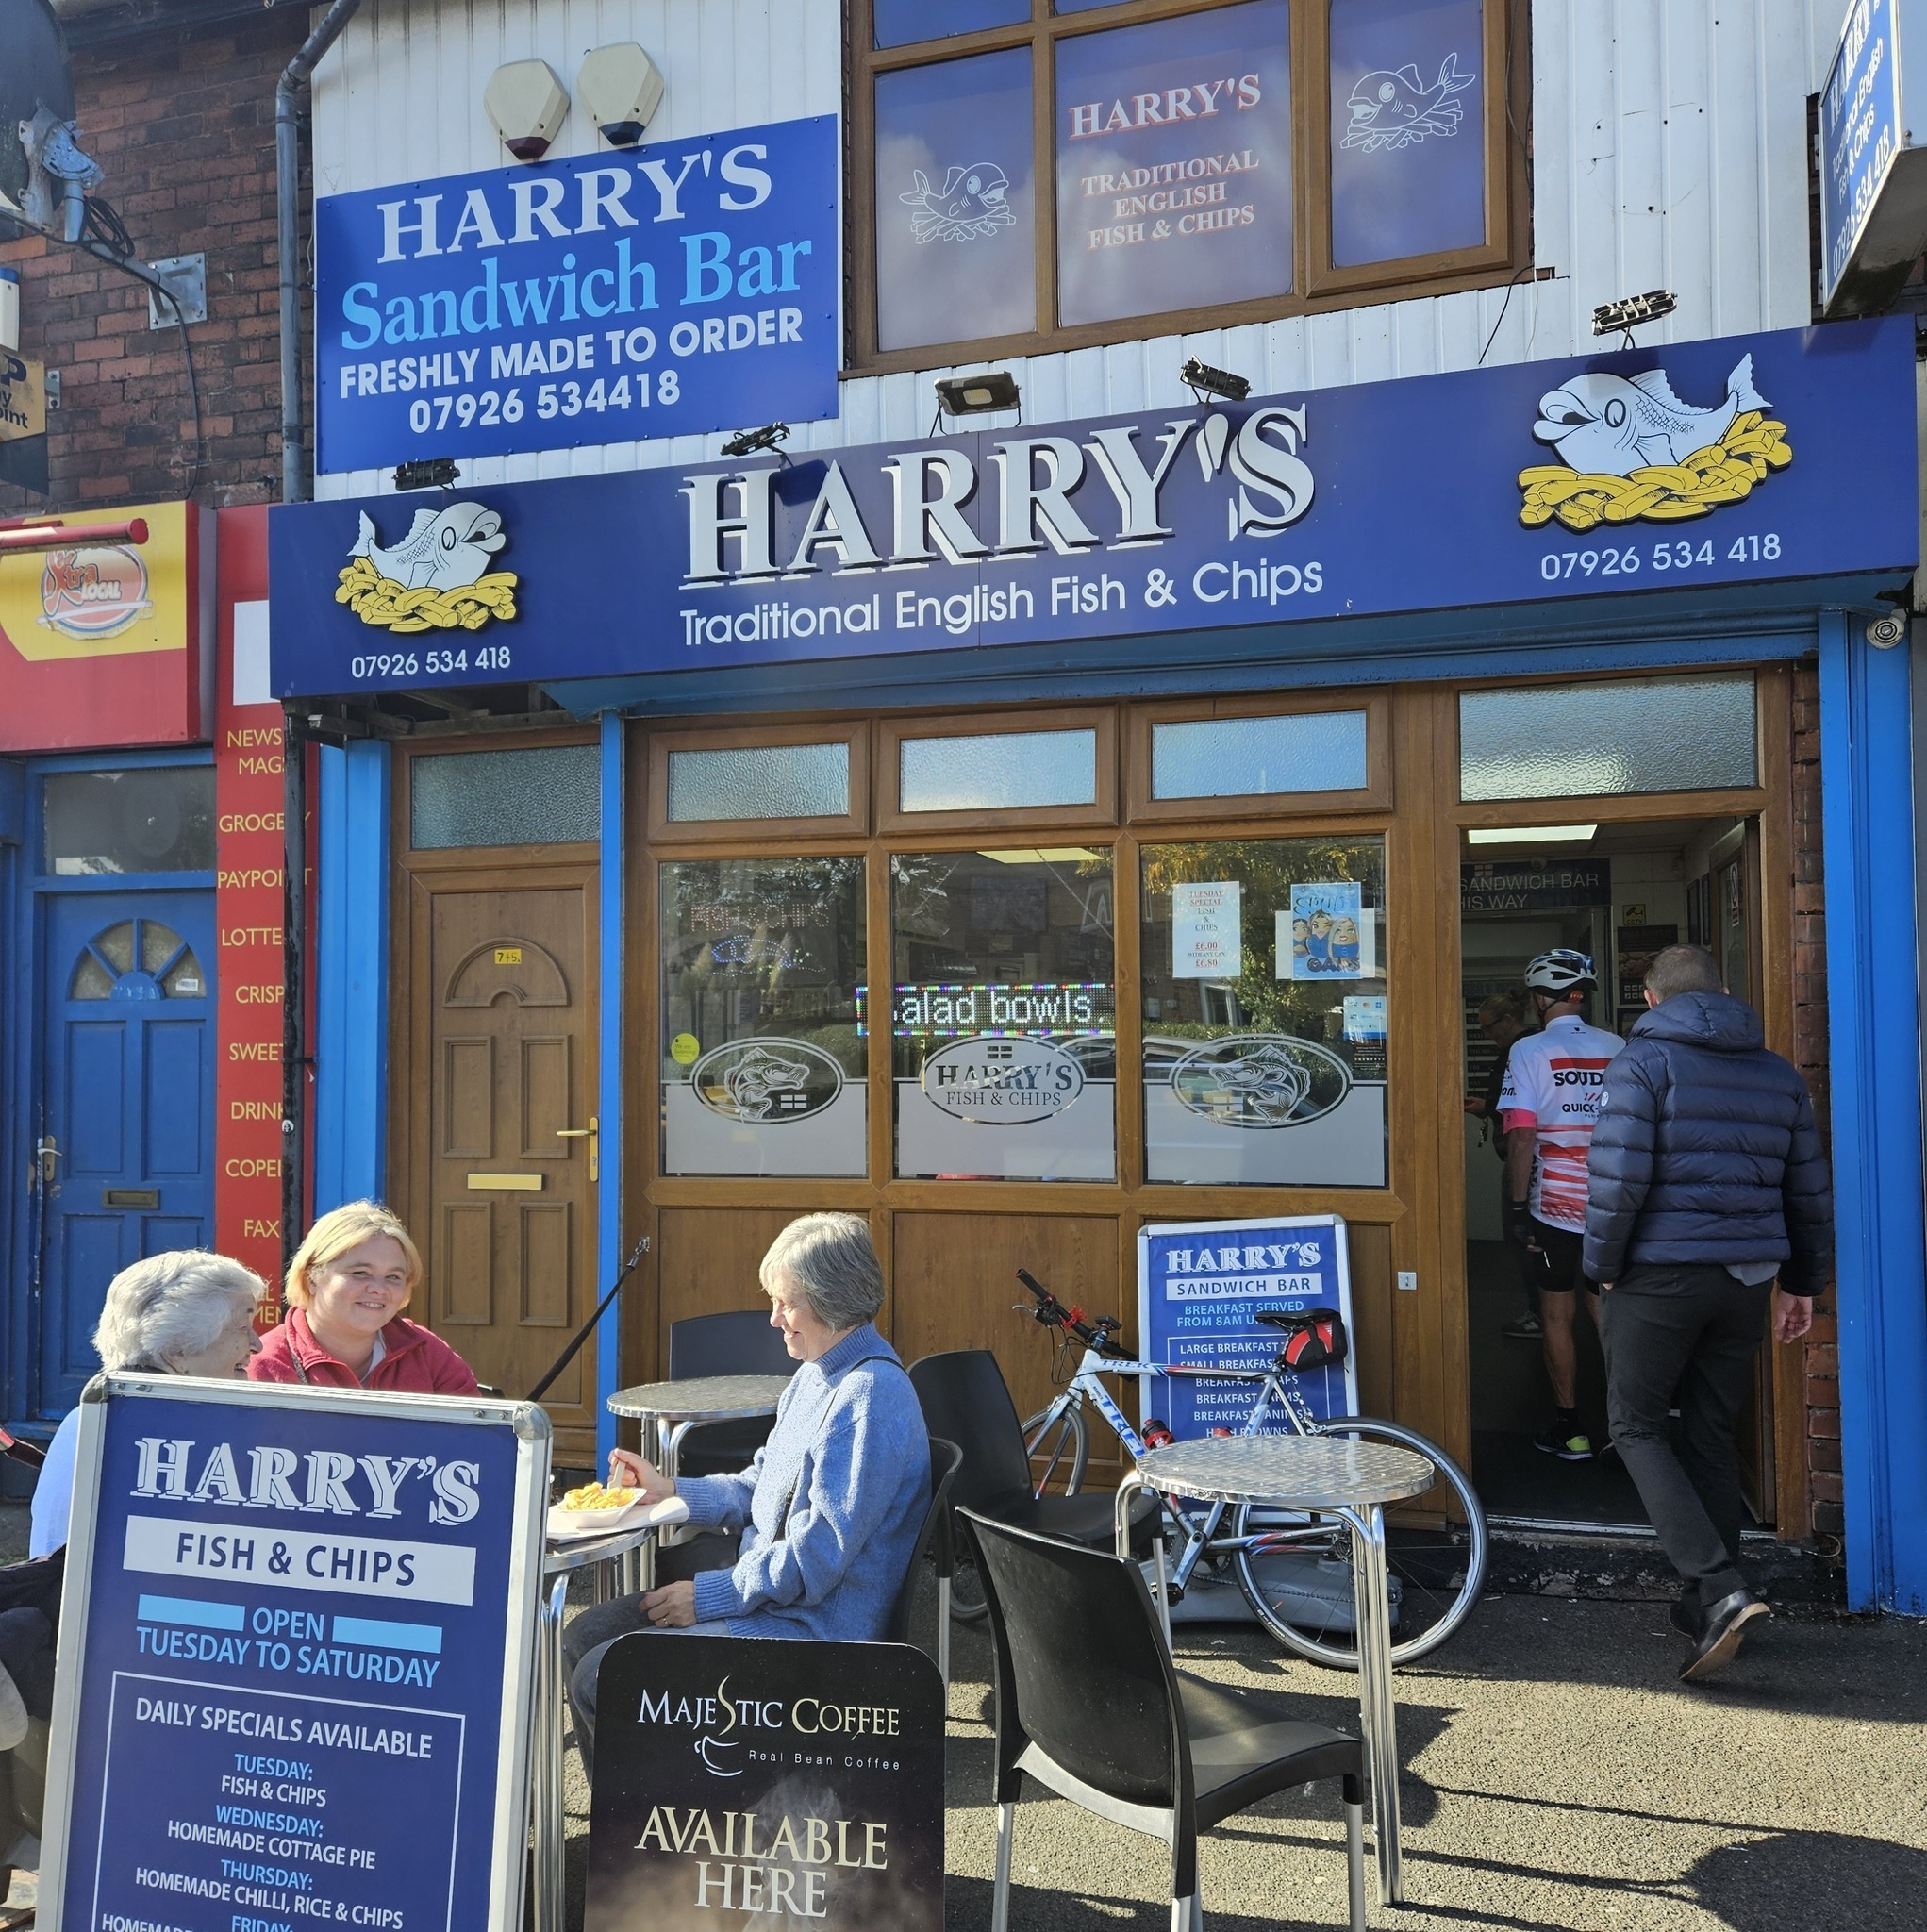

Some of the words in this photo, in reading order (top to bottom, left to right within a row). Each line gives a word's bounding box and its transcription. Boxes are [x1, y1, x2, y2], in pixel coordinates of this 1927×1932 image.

[1069, 74, 1261, 141] HARRY'S
[1081, 149, 1260, 198] TRADITIONAL
[376, 143, 772, 265] HARRY'S
[1112, 181, 1227, 219] ENGLISH
[1088, 225, 1144, 251] FISH
[1151, 218, 1171, 240] &
[1177, 204, 1256, 236] CHIPS
[341, 237, 659, 351] Sandwich
[679, 230, 812, 306] Bar
[339, 350, 480, 400] FRESHLY
[490, 336, 595, 380] MADE
[606, 326, 657, 364] TO
[668, 308, 804, 358] ORDER
[408, 400, 523, 434] 07926
[536, 369, 680, 419] 534418
[677, 403, 1317, 590] HARRY'S
[1540, 546, 1641, 581] 07926
[1652, 539, 1716, 571] 534
[1727, 532, 1783, 564] 418
[680, 595, 881, 646] Traditional
[896, 582, 1034, 635] English
[1051, 573, 1126, 616] Fish
[1144, 568, 1178, 607] &
[1192, 558, 1323, 606] Chips
[351, 653, 419, 678] 07926
[425, 650, 468, 673] 534
[474, 646, 511, 669] 418
[227, 728, 282, 748] NEWS
[239, 756, 285, 774] MAG
[217, 868, 313, 889] PAYPOIT
[1460, 875, 1555, 892] SANDWICH
[1560, 873, 1600, 889] BAR
[1488, 895, 1528, 908] WAY
[222, 928, 282, 946] LOTTE
[235, 985, 285, 1004] CRISP
[893, 991, 974, 1024] alad
[936, 1061, 1072, 1090] HARRY'S
[1553, 1071, 1603, 1087] SOUD
[946, 1091, 985, 1105] FISH
[990, 1092, 1003, 1106] &
[1008, 1091, 1062, 1106] CHIPS
[1562, 1103, 1599, 1113] QUICK-
[244, 1220, 280, 1238] FAX
[1166, 1242, 1321, 1273] HARRY'S
[1177, 1280, 1267, 1296] SANDWICH
[1278, 1277, 1311, 1291] BAR
[1177, 1316, 1212, 1327] FROM
[1216, 1315, 1242, 1326] 8AM
[1185, 1303, 1253, 1315] BREAKFAST
[1256, 1301, 1304, 1312] SERVED
[1180, 1343, 1215, 1355] LARGE
[1217, 1341, 1279, 1353] BREAKFAST
[1219, 1358, 1275, 1370] BREAKFAS
[1195, 1377, 1255, 1388] BREAKFAS
[1196, 1393, 1257, 1405] BREAKFAST
[130, 1437, 480, 1526] HARRY'S
[176, 1533, 256, 1571] FISH
[268, 1541, 292, 1574] &
[306, 1545, 416, 1587] CHIPS
[252, 1607, 324, 1641] OPEN
[136, 1626, 250, 1666] TUESDAY
[255, 1641, 291, 1669] TO
[297, 1646, 440, 1689] SATURDAY
[637, 1674, 783, 1737] MAJESTIC
[791, 1697, 901, 1740] COFFEE
[135, 1697, 198, 1726] DAILY
[200, 1706, 303, 1742] SPECIALS
[307, 1721, 433, 1758] AVAILABLE
[234, 1753, 313, 1781] TUESDAY:
[748, 1749, 785, 1763] Real
[794, 1753, 833, 1766] Bean
[844, 1756, 901, 1771] Coffee
[221, 1774, 257, 1796] FISH
[259, 1783, 274, 1801] &
[276, 1785, 326, 1807] CHIPS
[215, 1804, 324, 1838] WEDNESDAY:
[167, 1820, 265, 1854] HOMEMADE
[268, 1838, 346, 1866] COTTAGE
[349, 1849, 376, 1870] PIE
[633, 1805, 889, 1870] AVAILABLE
[221, 1859, 314, 1891] THURSDAY:
[693, 1861, 828, 1918] HERE
[135, 1867, 231, 1903] HOMEMADE
[234, 1885, 291, 1913] CHILLI,
[293, 1896, 332, 1919] RICE
[334, 1904, 348, 1921] &
[350, 1906, 404, 1931] CHIPS
[101, 1913, 195, 1932] HOMEM
